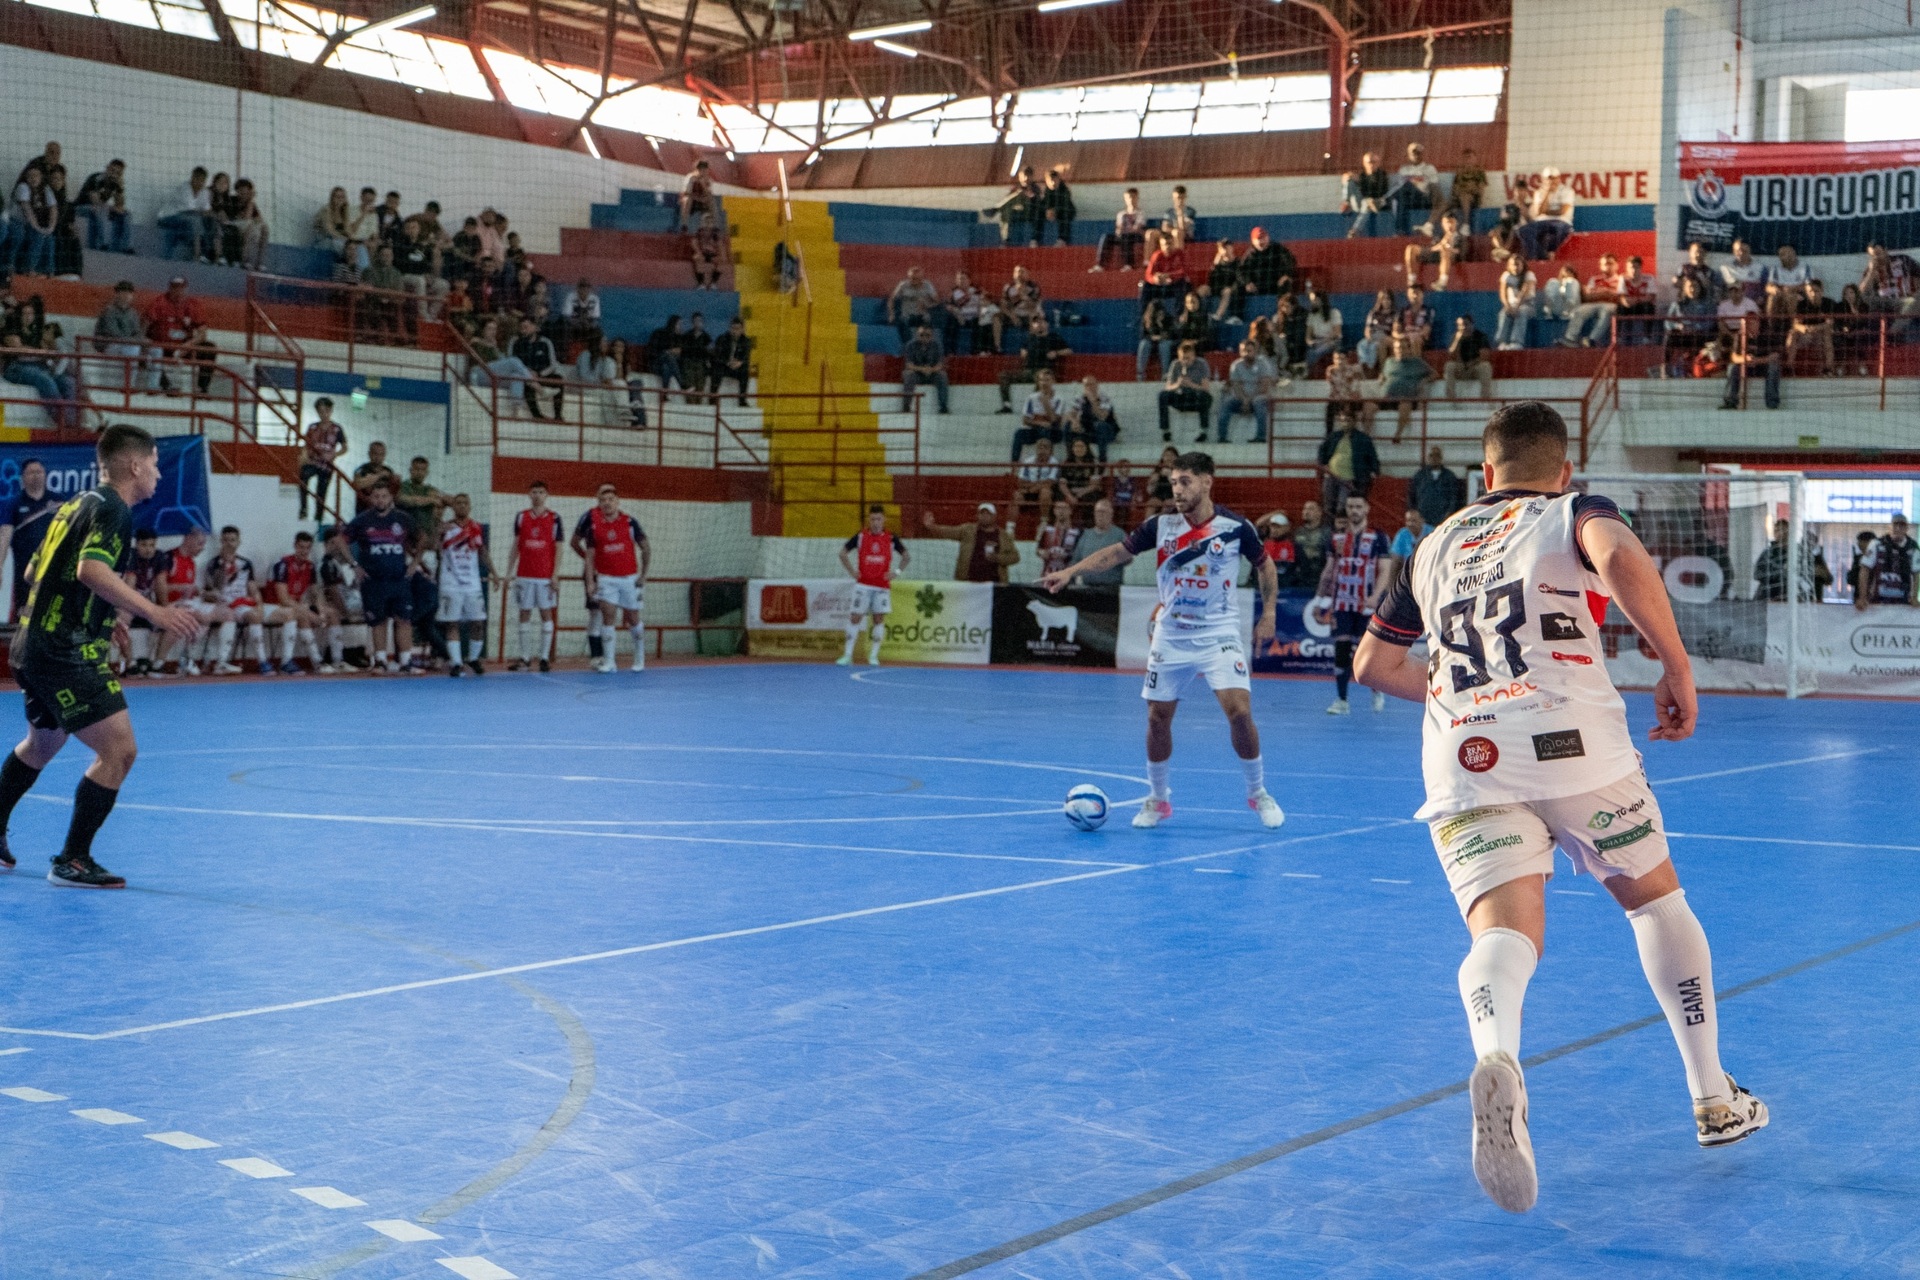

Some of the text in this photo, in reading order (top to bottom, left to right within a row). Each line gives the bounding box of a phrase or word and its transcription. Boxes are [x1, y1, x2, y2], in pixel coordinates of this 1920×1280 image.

[1743, 168, 1917, 217] URUGUAIA
[1174, 577, 1210, 590] KTO
[1439, 577, 1530, 694] 97
[1268, 638, 1336, 658] ArtGra
[1451, 713, 1497, 729] MOHR
[1466, 744, 1483, 757] BRA
[1677, 975, 1706, 1028] GAMA
